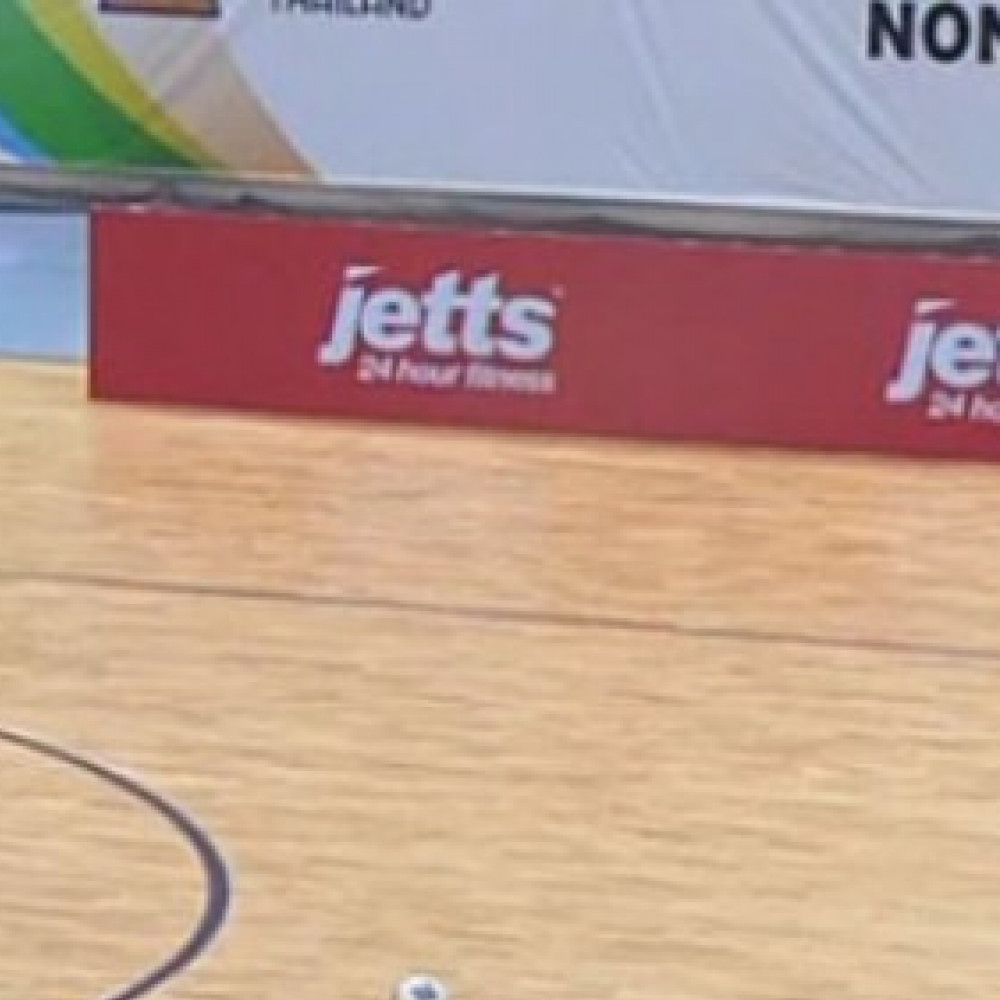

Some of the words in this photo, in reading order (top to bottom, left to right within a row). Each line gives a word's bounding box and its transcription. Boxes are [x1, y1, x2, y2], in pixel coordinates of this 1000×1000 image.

[317, 265, 557, 364] jetts
[356, 353, 394, 383] 24
[396, 356, 460, 388] hour
[885, 298, 1000, 404] je
[928, 390, 965, 418] 24
